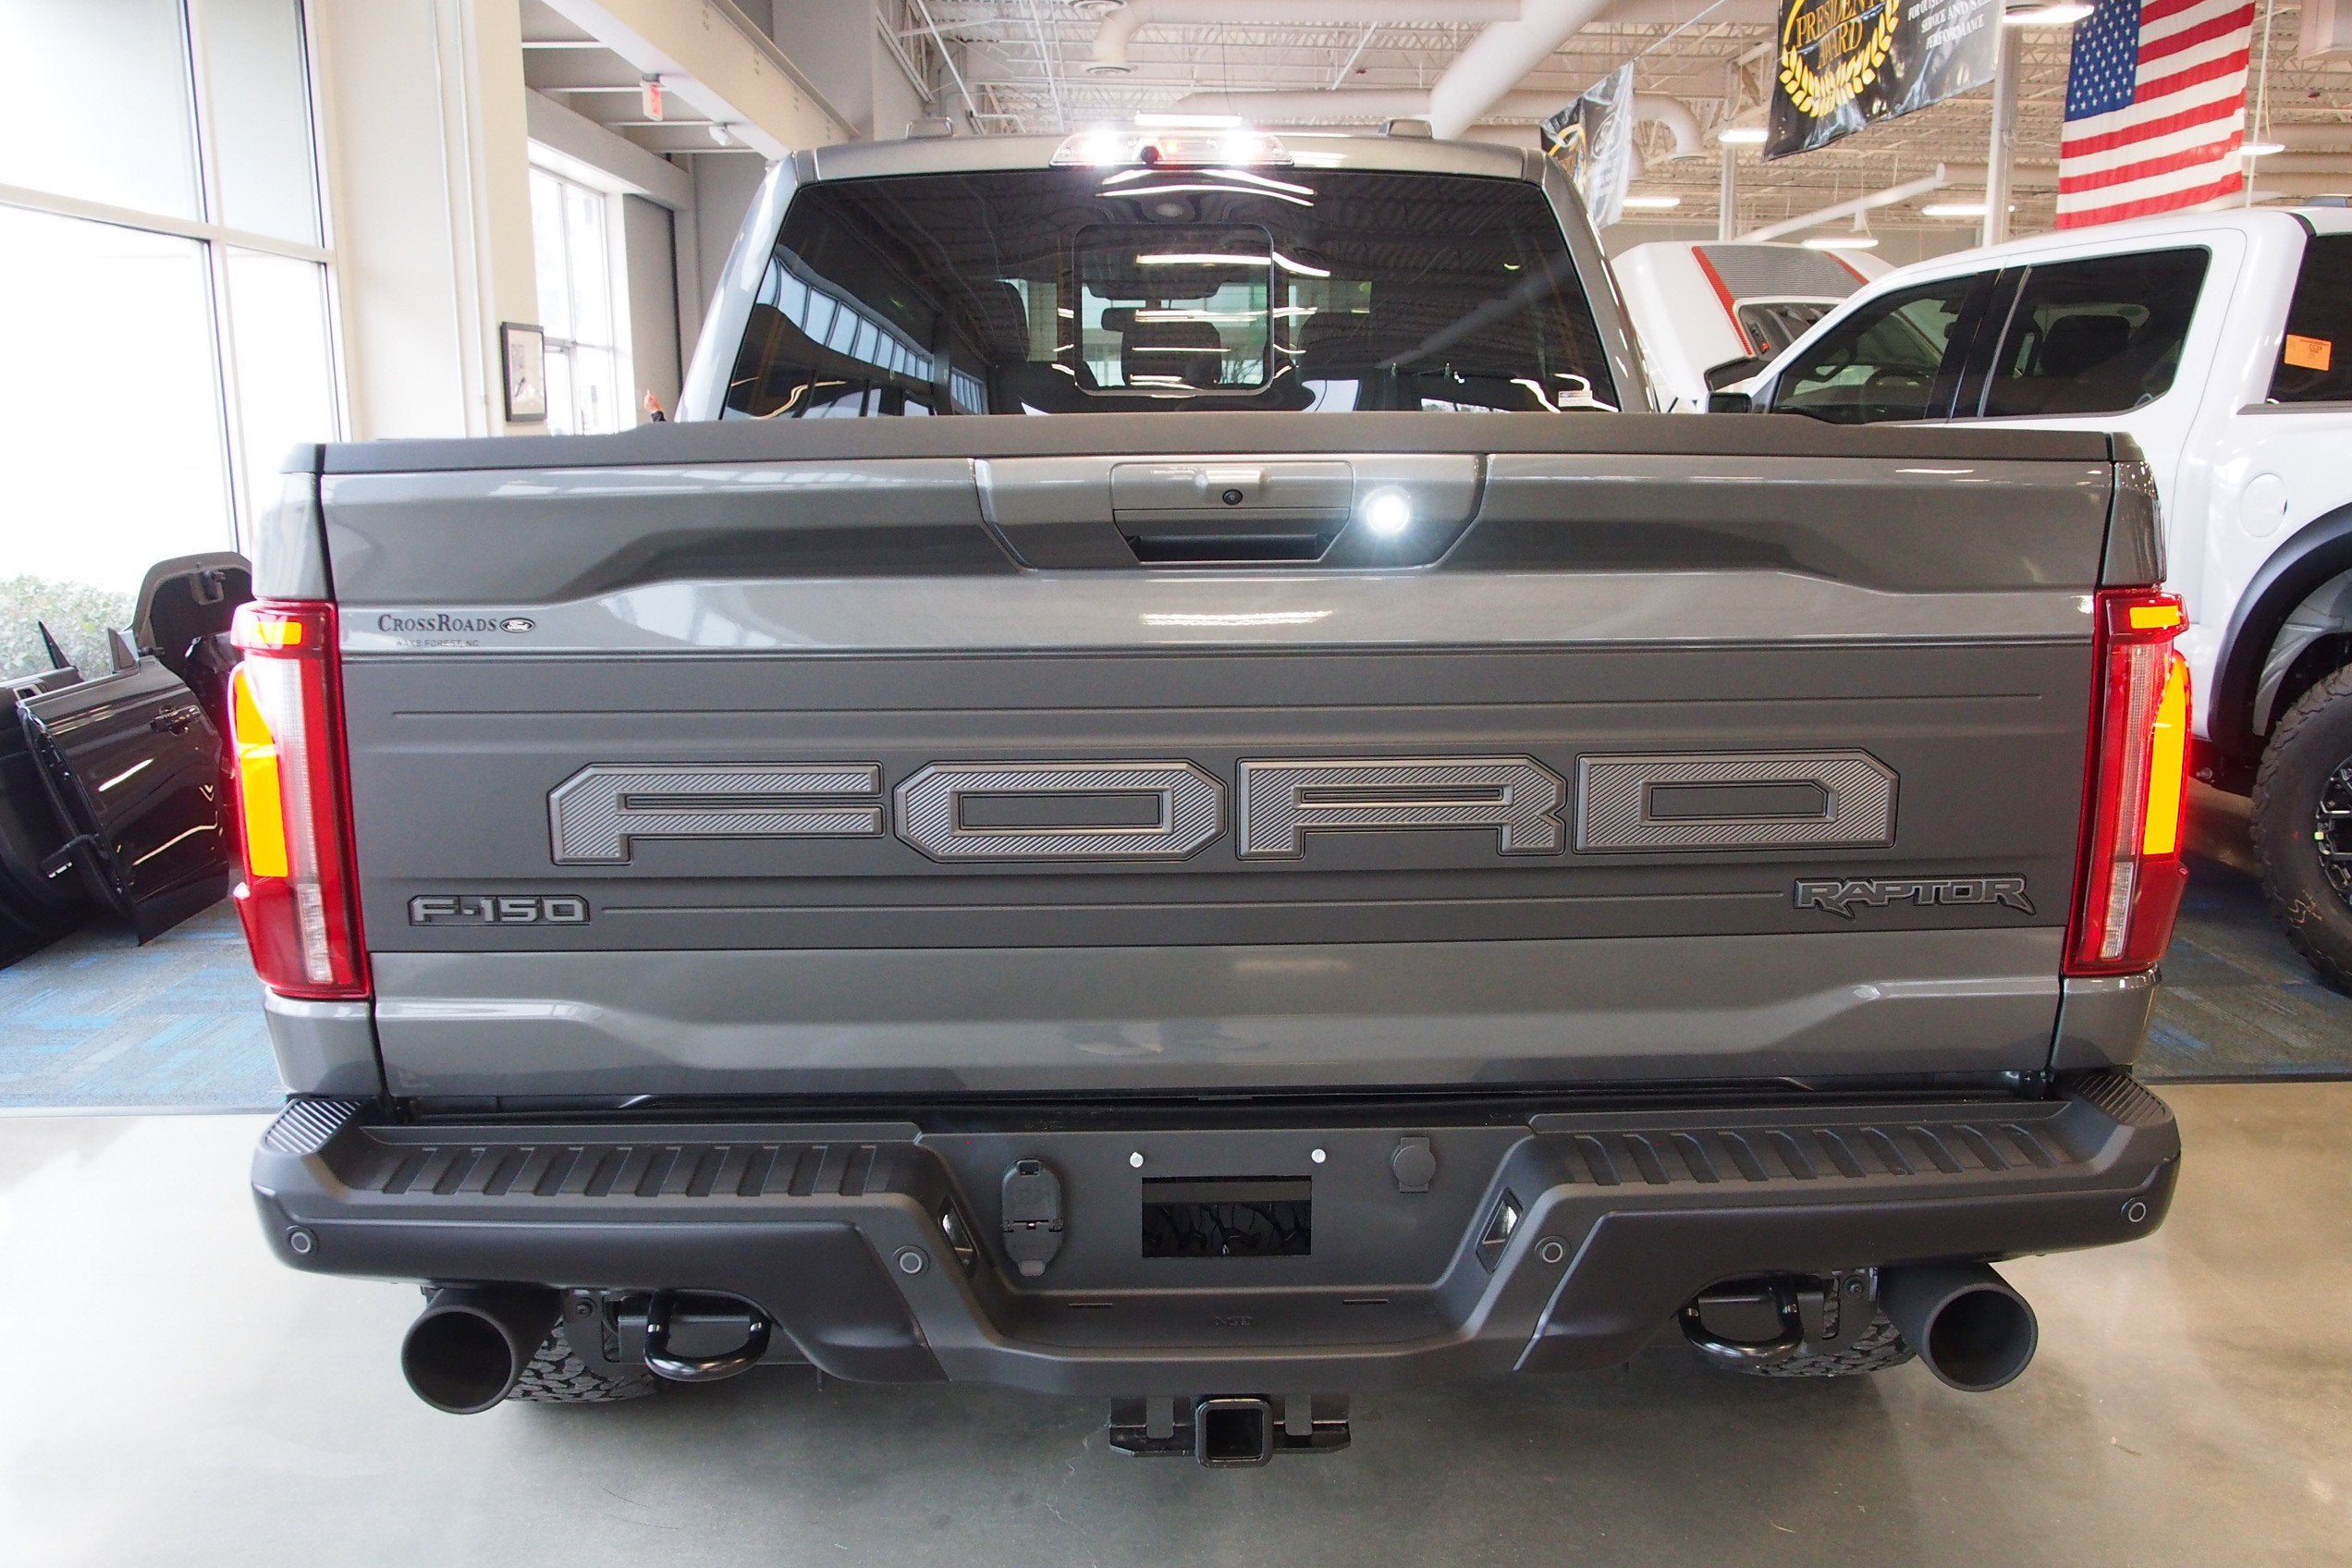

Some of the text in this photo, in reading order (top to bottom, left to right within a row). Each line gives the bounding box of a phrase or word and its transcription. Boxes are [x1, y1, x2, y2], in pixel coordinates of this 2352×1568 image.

[1948, 1, 1969, 19] AND
[1926, 13, 1984, 50] PERFORMANCE
[548, 748, 1900, 865] FORD
[408, 895, 590, 925] F-150
[1794, 874, 2036, 921] RAPTOR
